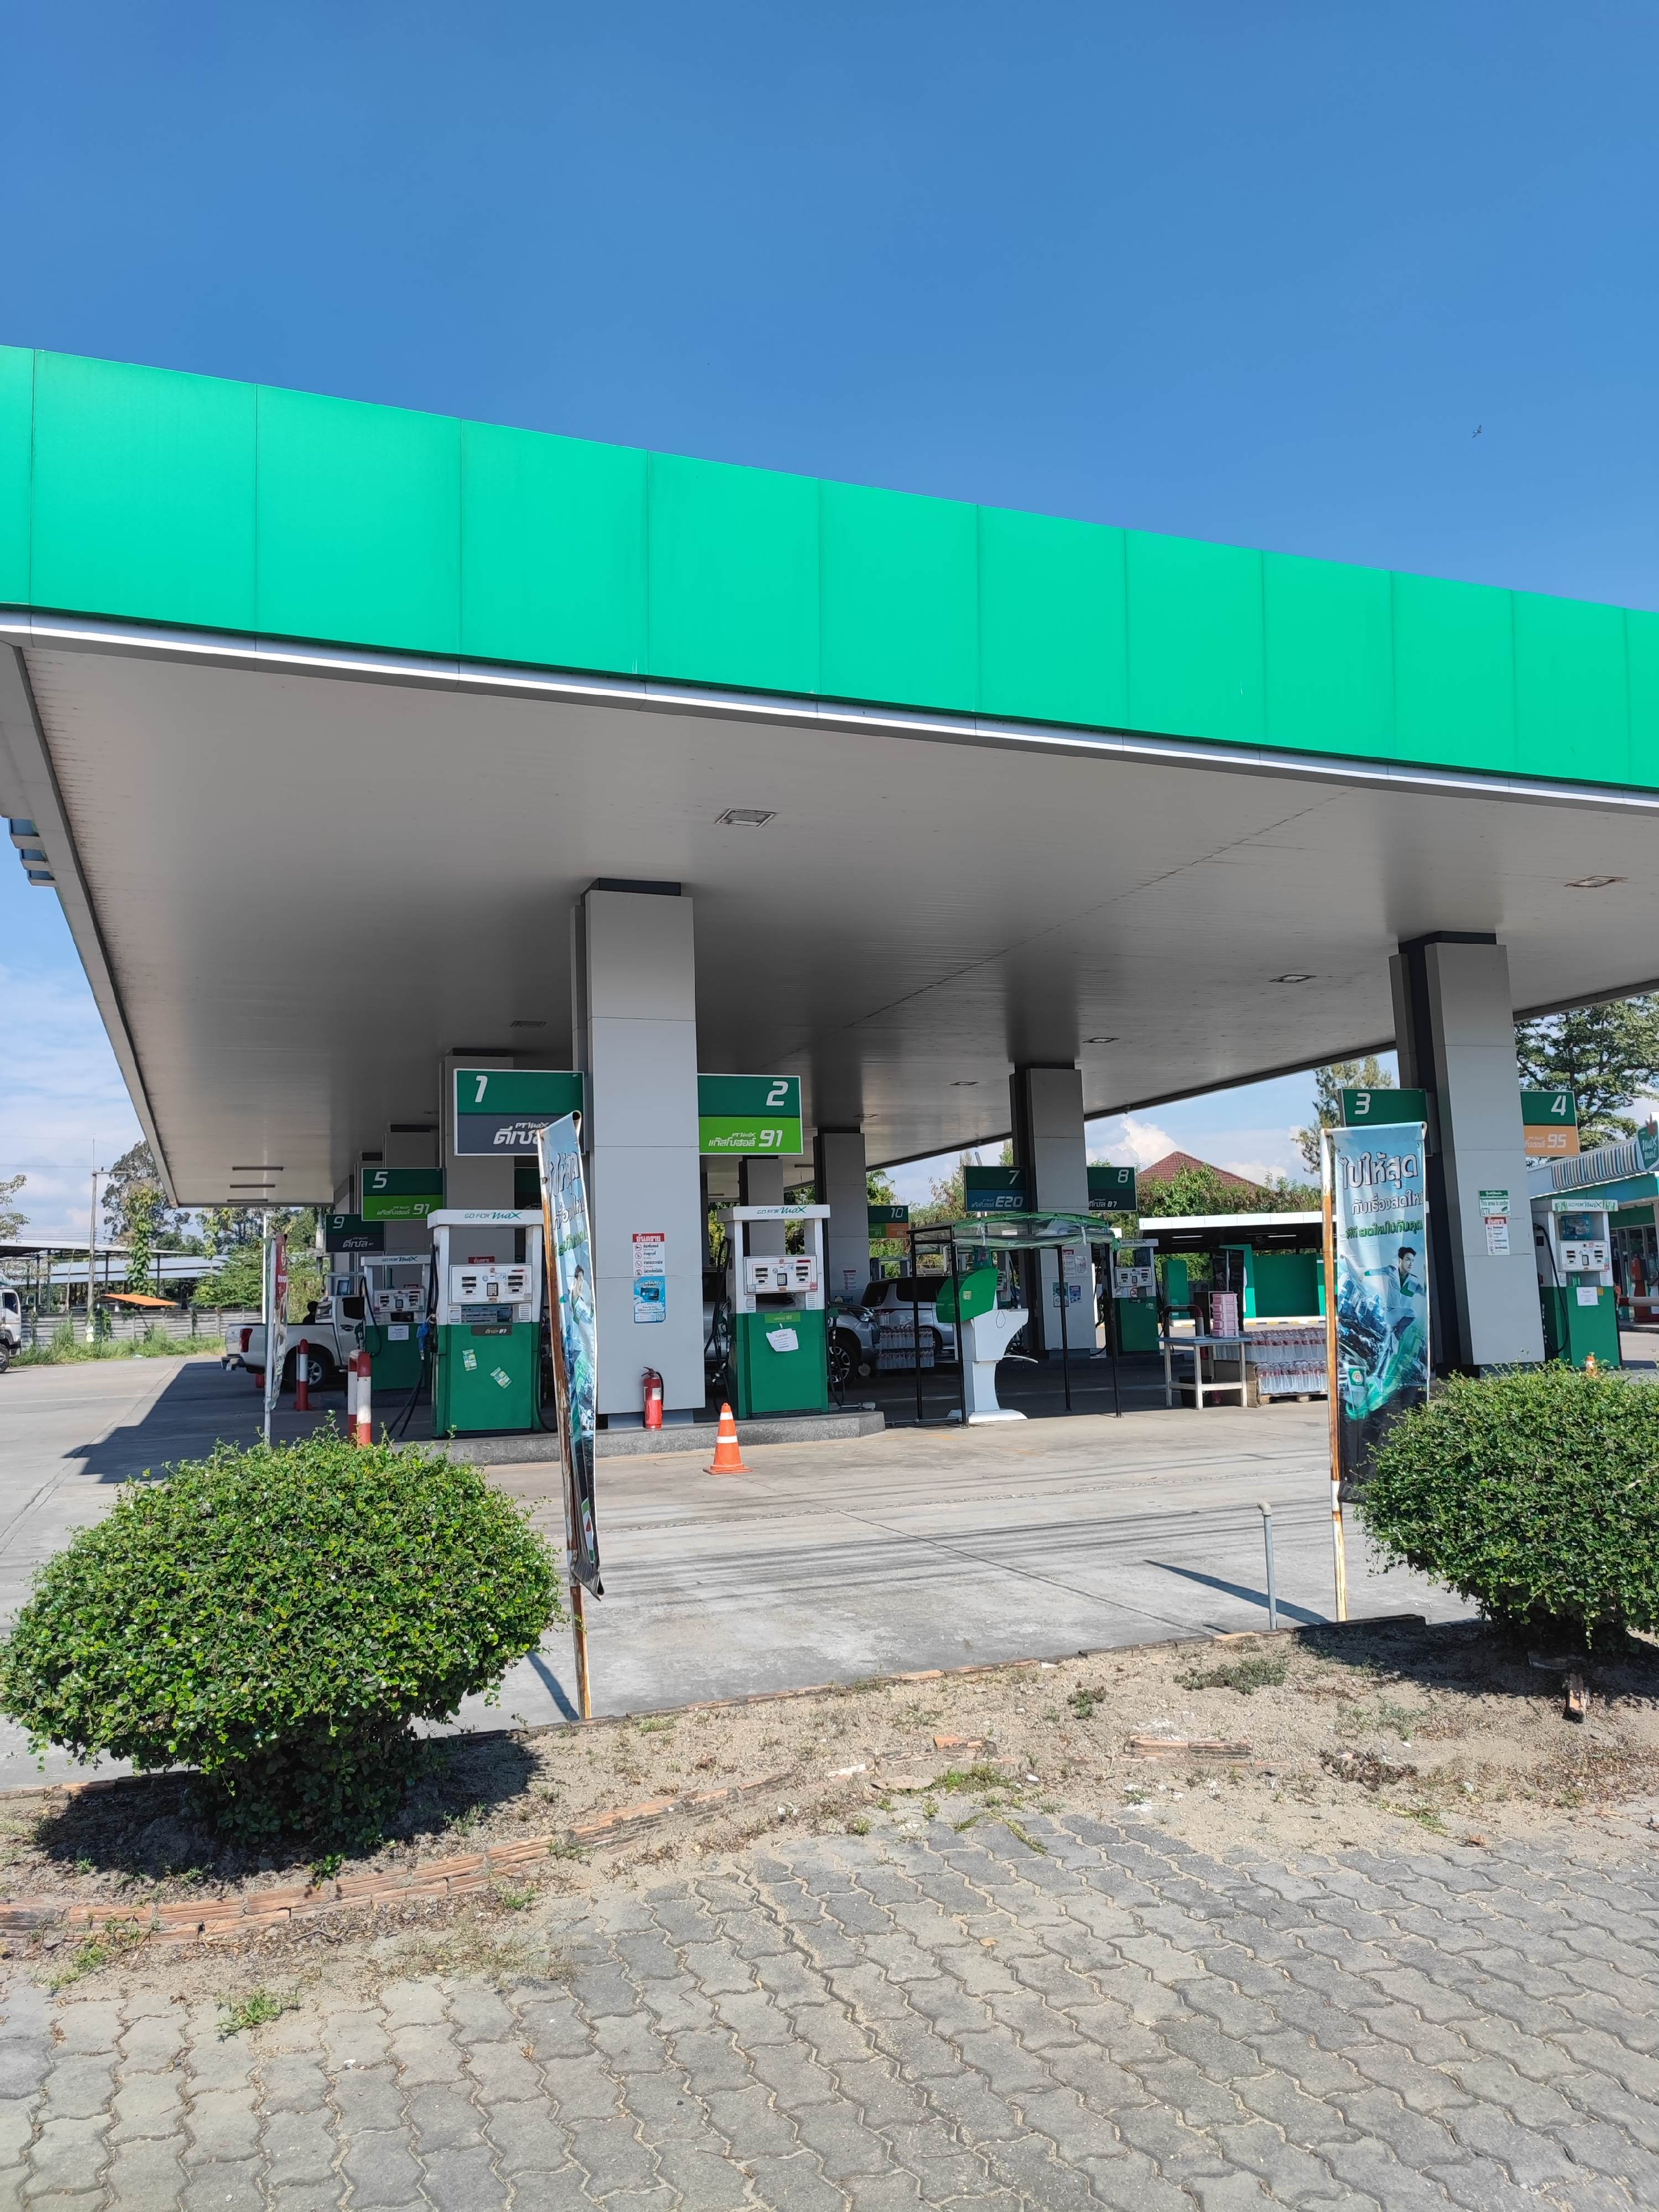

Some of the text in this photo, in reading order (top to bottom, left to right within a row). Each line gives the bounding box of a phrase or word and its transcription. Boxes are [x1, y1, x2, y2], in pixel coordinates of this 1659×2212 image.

[765, 1081, 789, 1106] 2
[1354, 1093, 1371, 1115] 3
[1550, 1095, 1566, 1116] 4
[758, 1130, 783, 1147] 91
[1547, 1134, 1567, 1148] 95
[1008, 1170, 1020, 1185] 7
[1117, 1169, 1129, 1184] 8
[1338, 1151, 1419, 1189] ไปให้สุด
[372, 1171, 389, 1189] 5
[412, 1203, 430, 1215] 91
[995, 1195, 1024, 1208] E20
[891, 1207, 904, 1218] 10
[332, 1216, 345, 1229] 9
